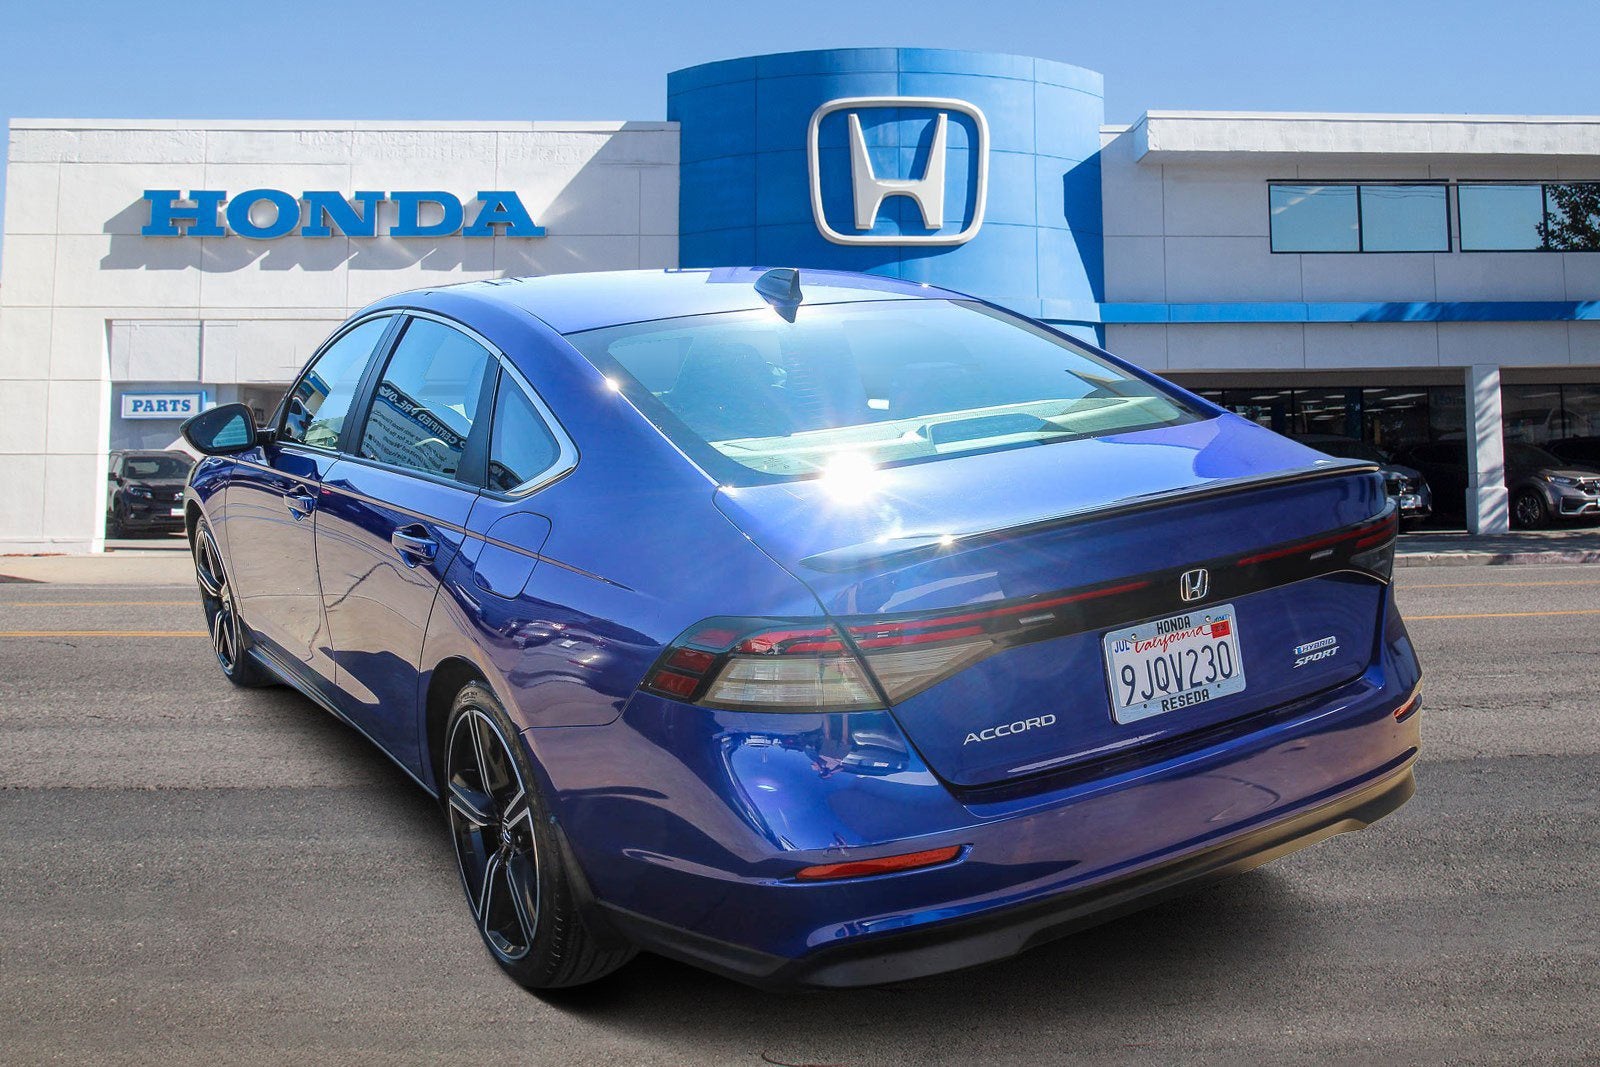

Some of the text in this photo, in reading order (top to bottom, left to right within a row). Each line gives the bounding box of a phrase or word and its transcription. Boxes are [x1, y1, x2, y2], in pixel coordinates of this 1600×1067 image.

[141, 188, 547, 240] HONDA
[132, 399, 191, 413] PARTS
[1156, 616, 1191, 635] HONDA
[1114, 640, 1130, 653] JUL
[1134, 625, 1203, 653] California
[1293, 646, 1340, 669] SPORT
[1121, 641, 1233, 706] 9JQV230
[1162, 689, 1210, 712] RESEDA
[963, 713, 1057, 746] ACCORD
